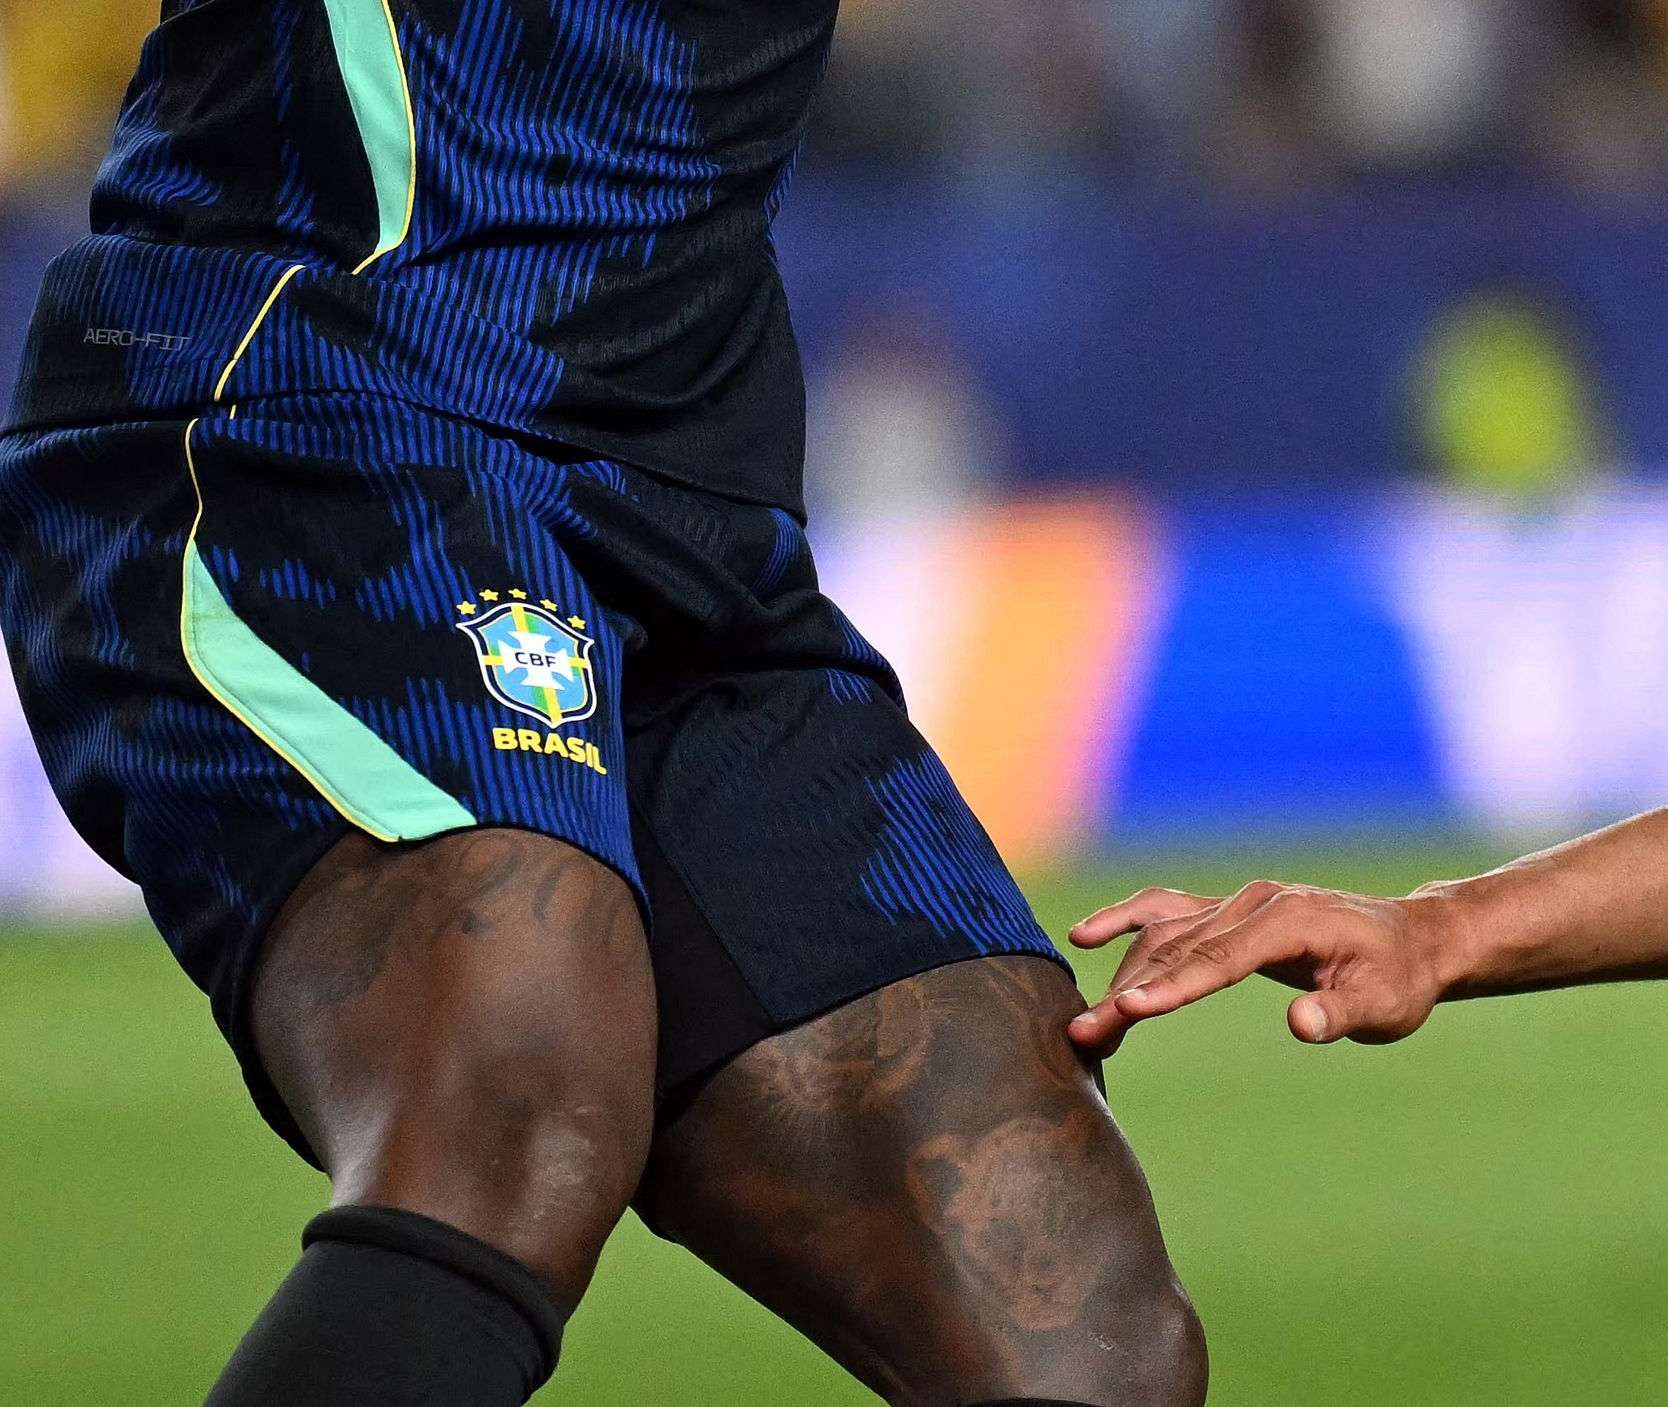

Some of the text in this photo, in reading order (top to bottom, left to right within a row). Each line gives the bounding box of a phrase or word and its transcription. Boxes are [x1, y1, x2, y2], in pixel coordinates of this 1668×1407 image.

[83, 328, 193, 352] AERO-FIT
[515, 652, 557, 668] CBF
[492, 727, 608, 776] BRASIL
